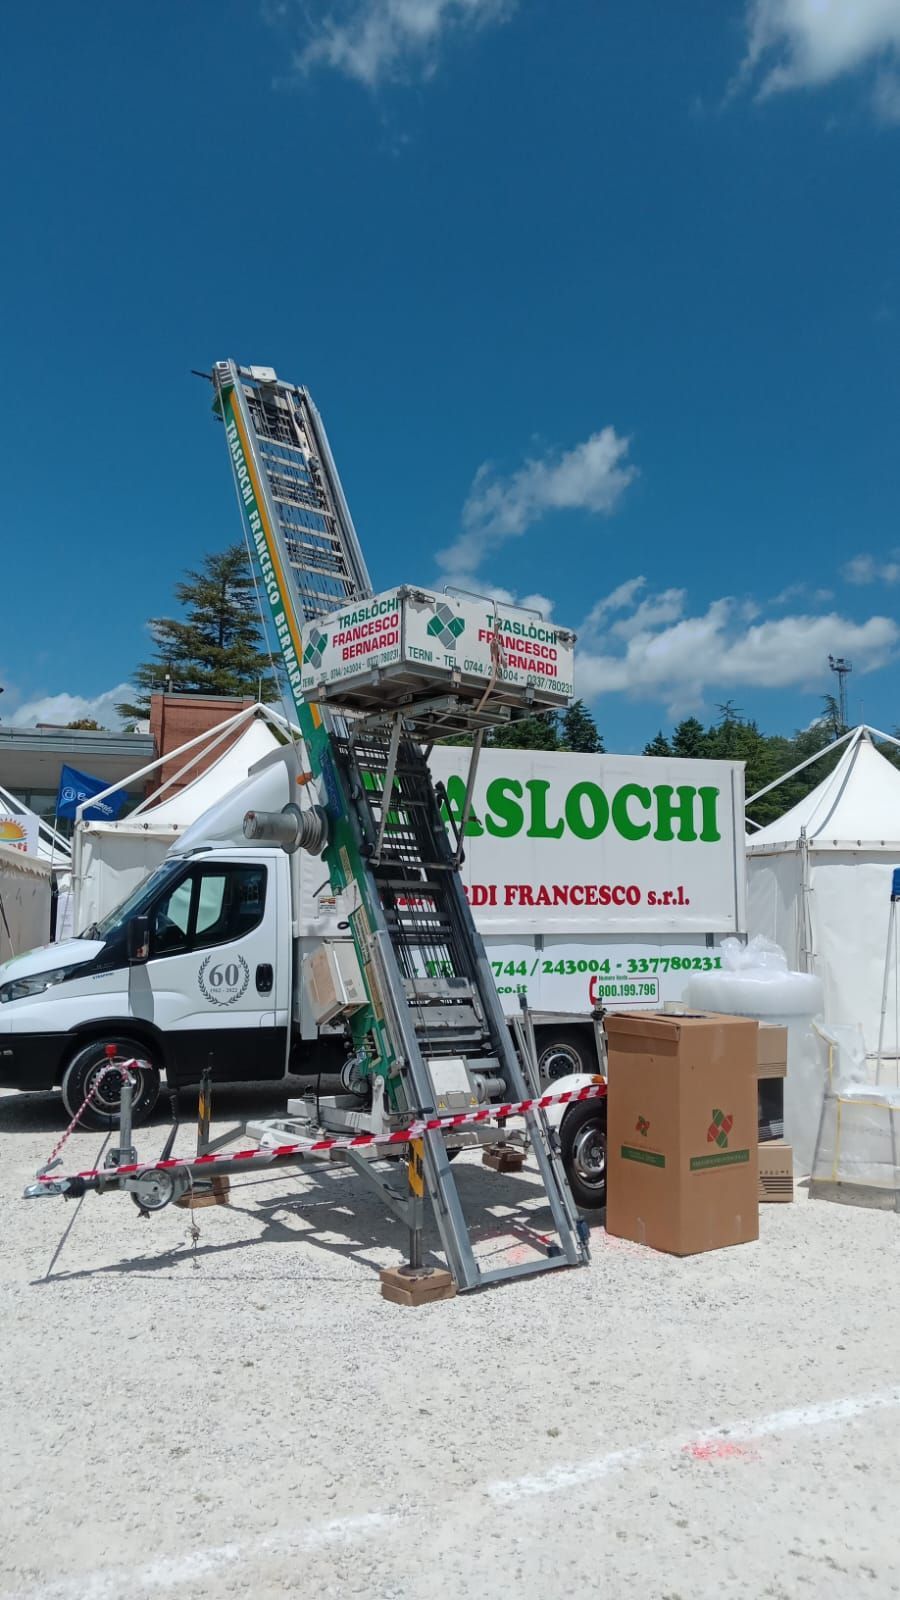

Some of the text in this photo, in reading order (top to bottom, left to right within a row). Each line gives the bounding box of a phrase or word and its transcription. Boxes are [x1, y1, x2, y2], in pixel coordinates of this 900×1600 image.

[225, 419, 305, 707] TRASLOCHI FRANCESCO BERNARDI
[332, 613, 399, 649] FRANCESCO
[342, 630, 399, 661] BERNARDI
[408, 646, 433, 663] TERNI
[478, 629, 558, 661] FRANCESCO
[440, 775, 722, 843] ASLOCHI
[504, 884, 641, 906] FRANCESCO
[647, 885, 690, 906] s.r.l.
[208, 963, 239, 987] 60
[627, 956, 722, 974] 337780231
[598, 983, 656, 997] 800.199.796
